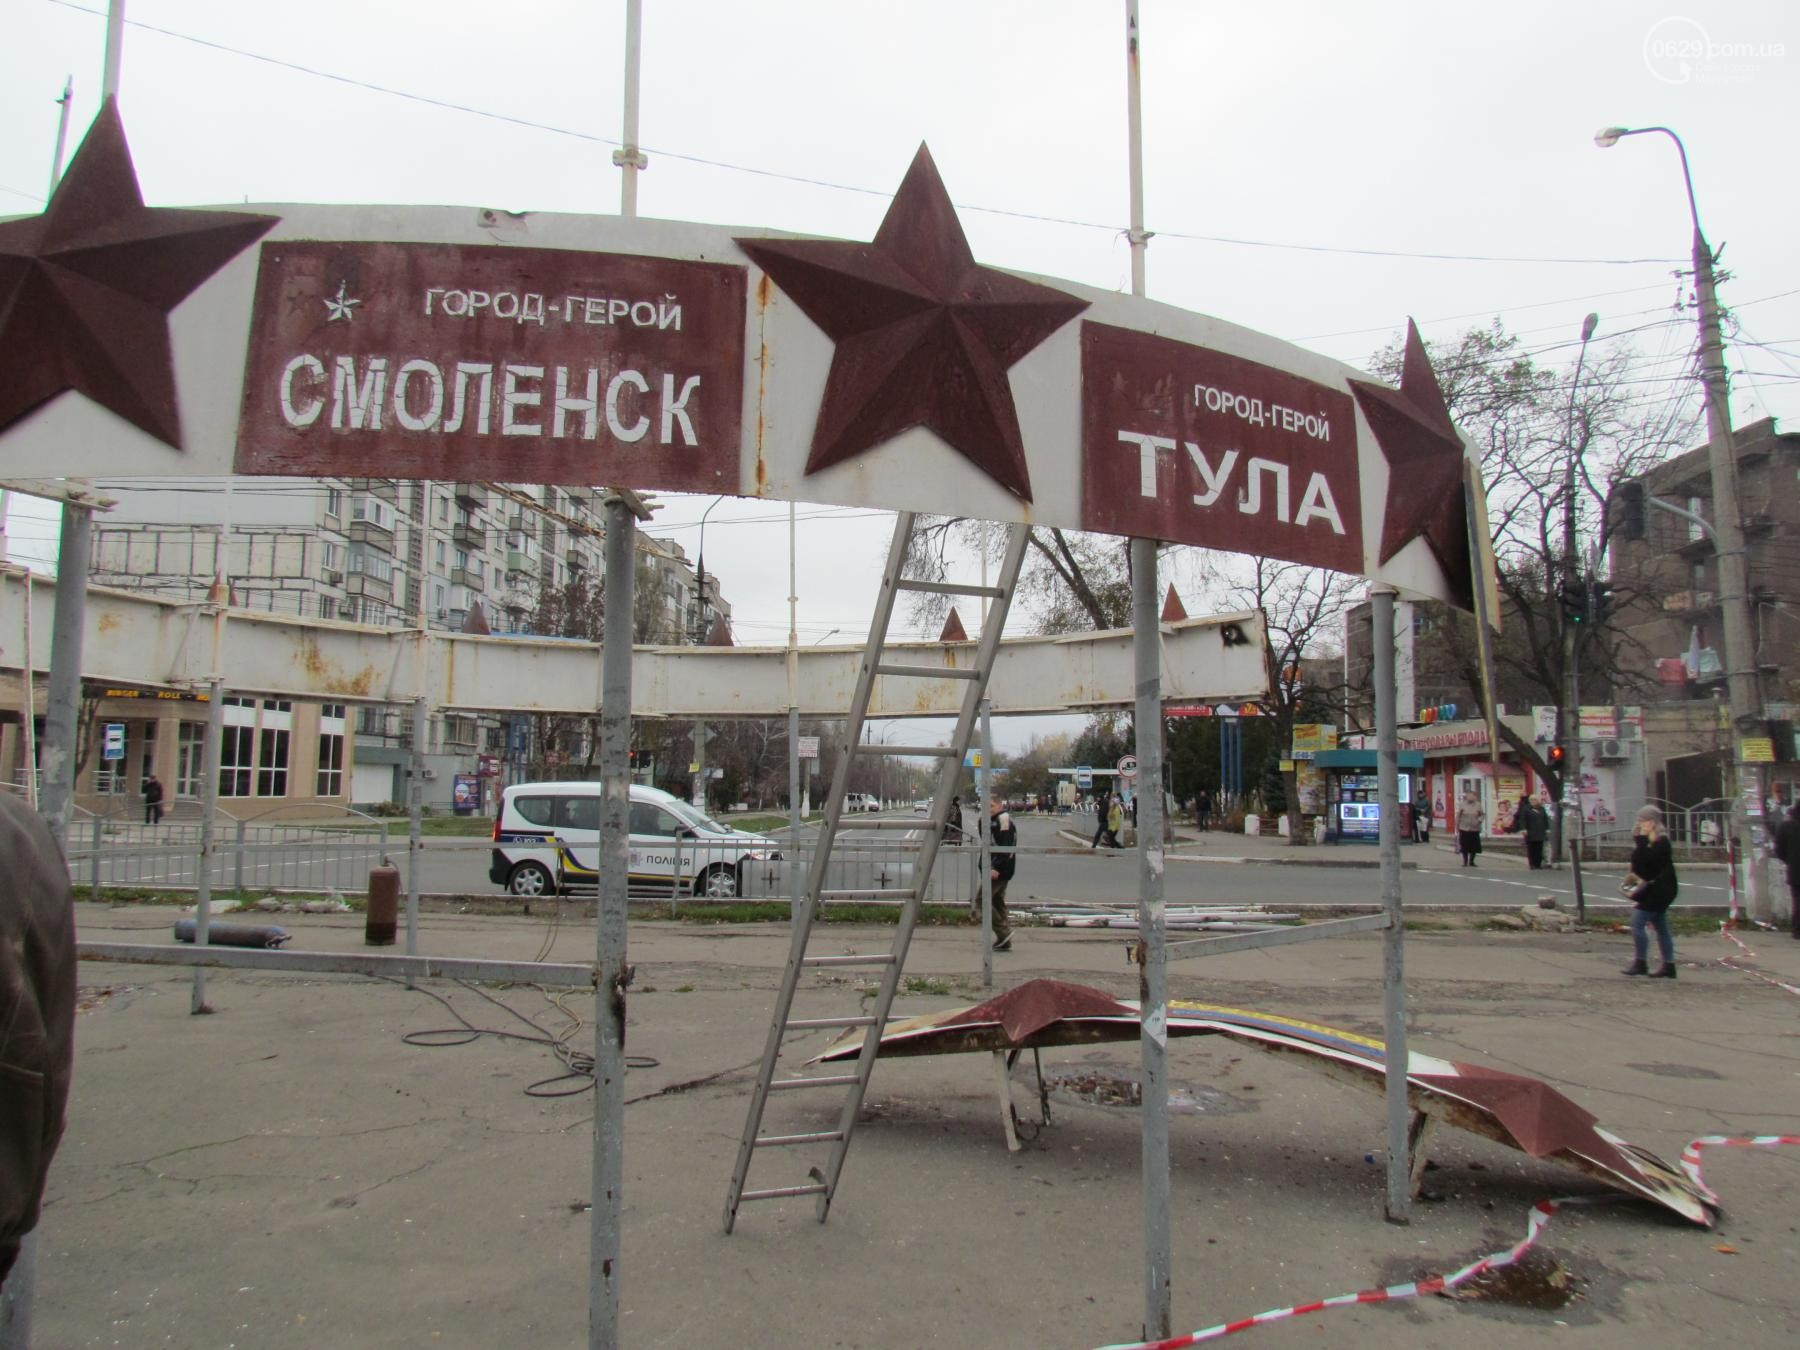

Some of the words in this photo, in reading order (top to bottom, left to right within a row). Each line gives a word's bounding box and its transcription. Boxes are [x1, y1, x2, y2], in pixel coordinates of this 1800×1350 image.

[424, 289, 682, 331] ГОРОД-ГЕРОЙ
[280, 353, 701, 446] СМОЛЕНСК
[1194, 384, 1330, 442] ГОРОД-ГЕРОЙ
[1118, 430, 1346, 535] ТУЛА
